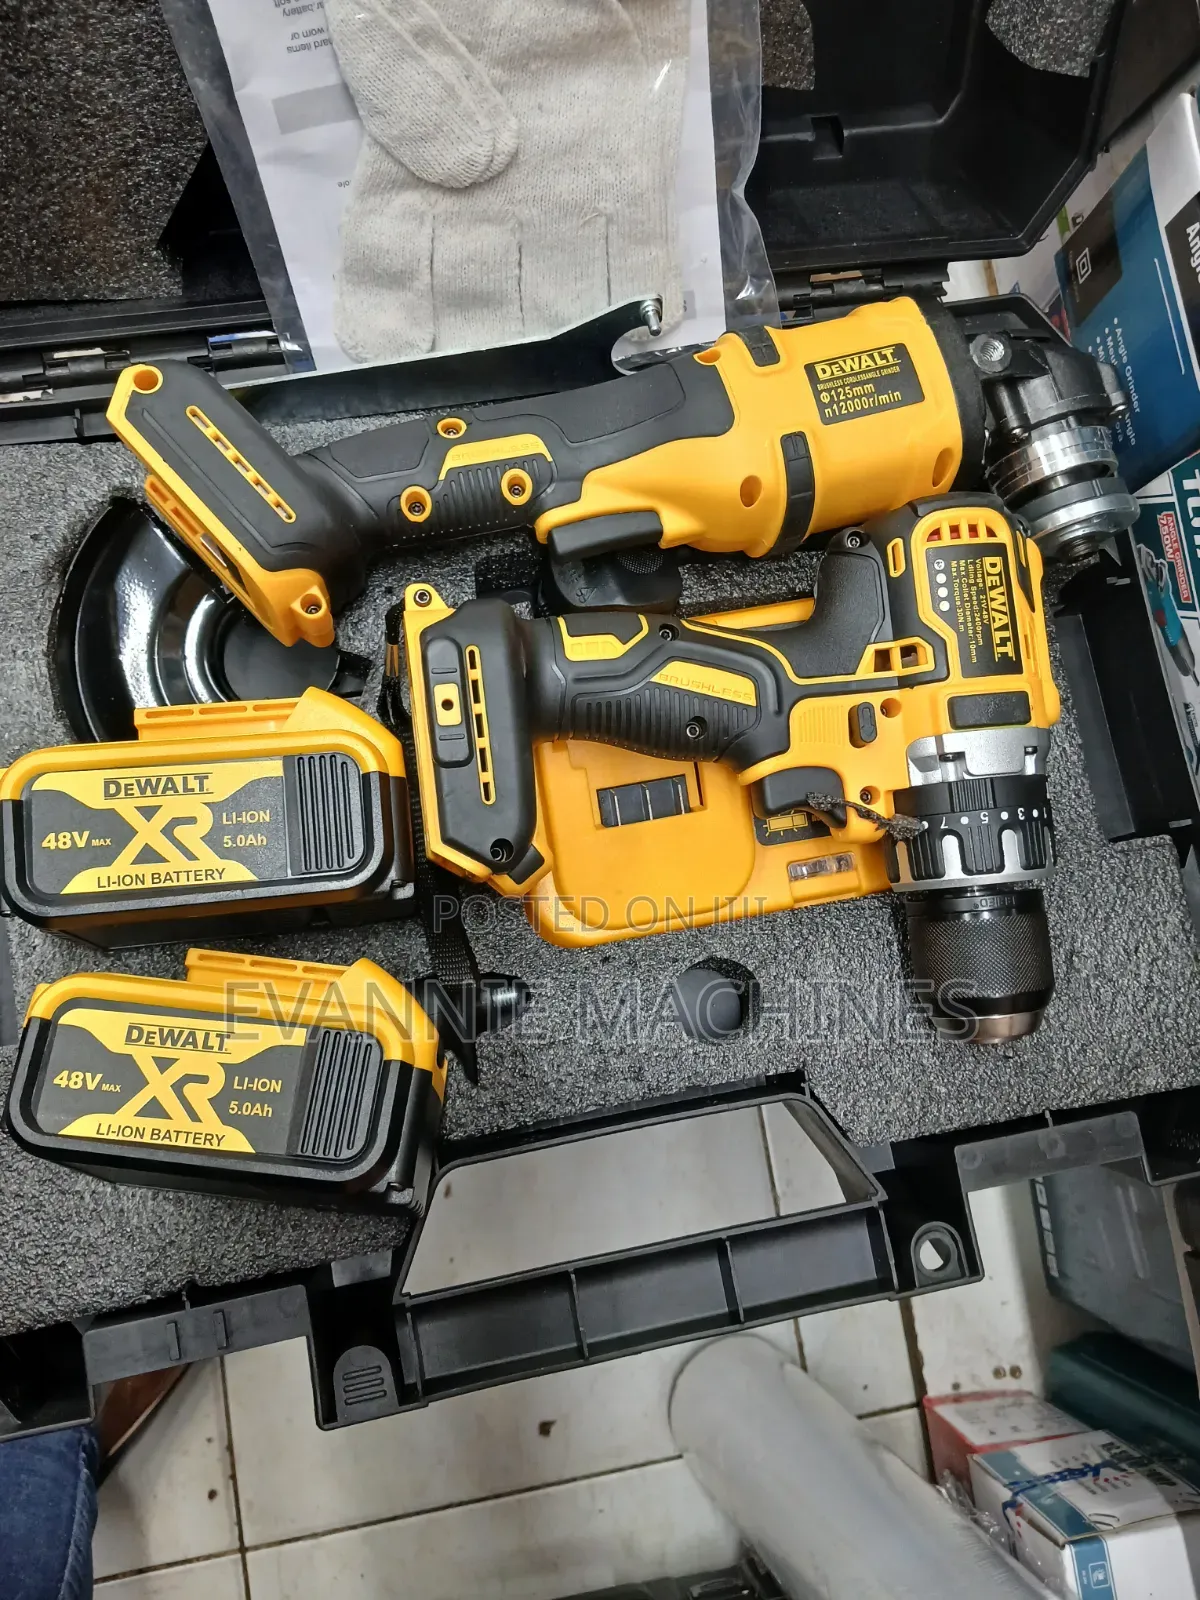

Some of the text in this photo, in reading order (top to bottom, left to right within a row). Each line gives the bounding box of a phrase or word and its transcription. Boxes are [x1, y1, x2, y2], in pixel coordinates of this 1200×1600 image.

[290, 32, 300, 41] or
[286, 43, 312, 54] items
[1115, 328, 1140, 413] Angle Grinder
[824, 390, 902, 418] n12000r/min
[1159, 515, 1174, 559] 750W
[1167, 516, 1188, 598] ANGLE GRINDER
[659, 673, 752, 701] BRUSHLESS
[222, 809, 271, 825] LI-ION
[940, 816, 948, 829] 7
[980, 811, 989, 824] 5
[1017, 807, 1025, 820] 3
[41, 830, 112, 850] 48V MAX
[111, 802, 221, 867] XR
[223, 834, 267, 848] 5.0Ah
[97, 867, 226, 889] LI-ION BATTERY
[52, 1070, 122, 1093] 48V MAX
[114, 1054, 225, 1125] XR
[233, 1076, 282, 1093] LI-ION
[228, 1101, 273, 1117] 5.0Ah
[96, 1123, 225, 1147] LI-ION BATTERY
